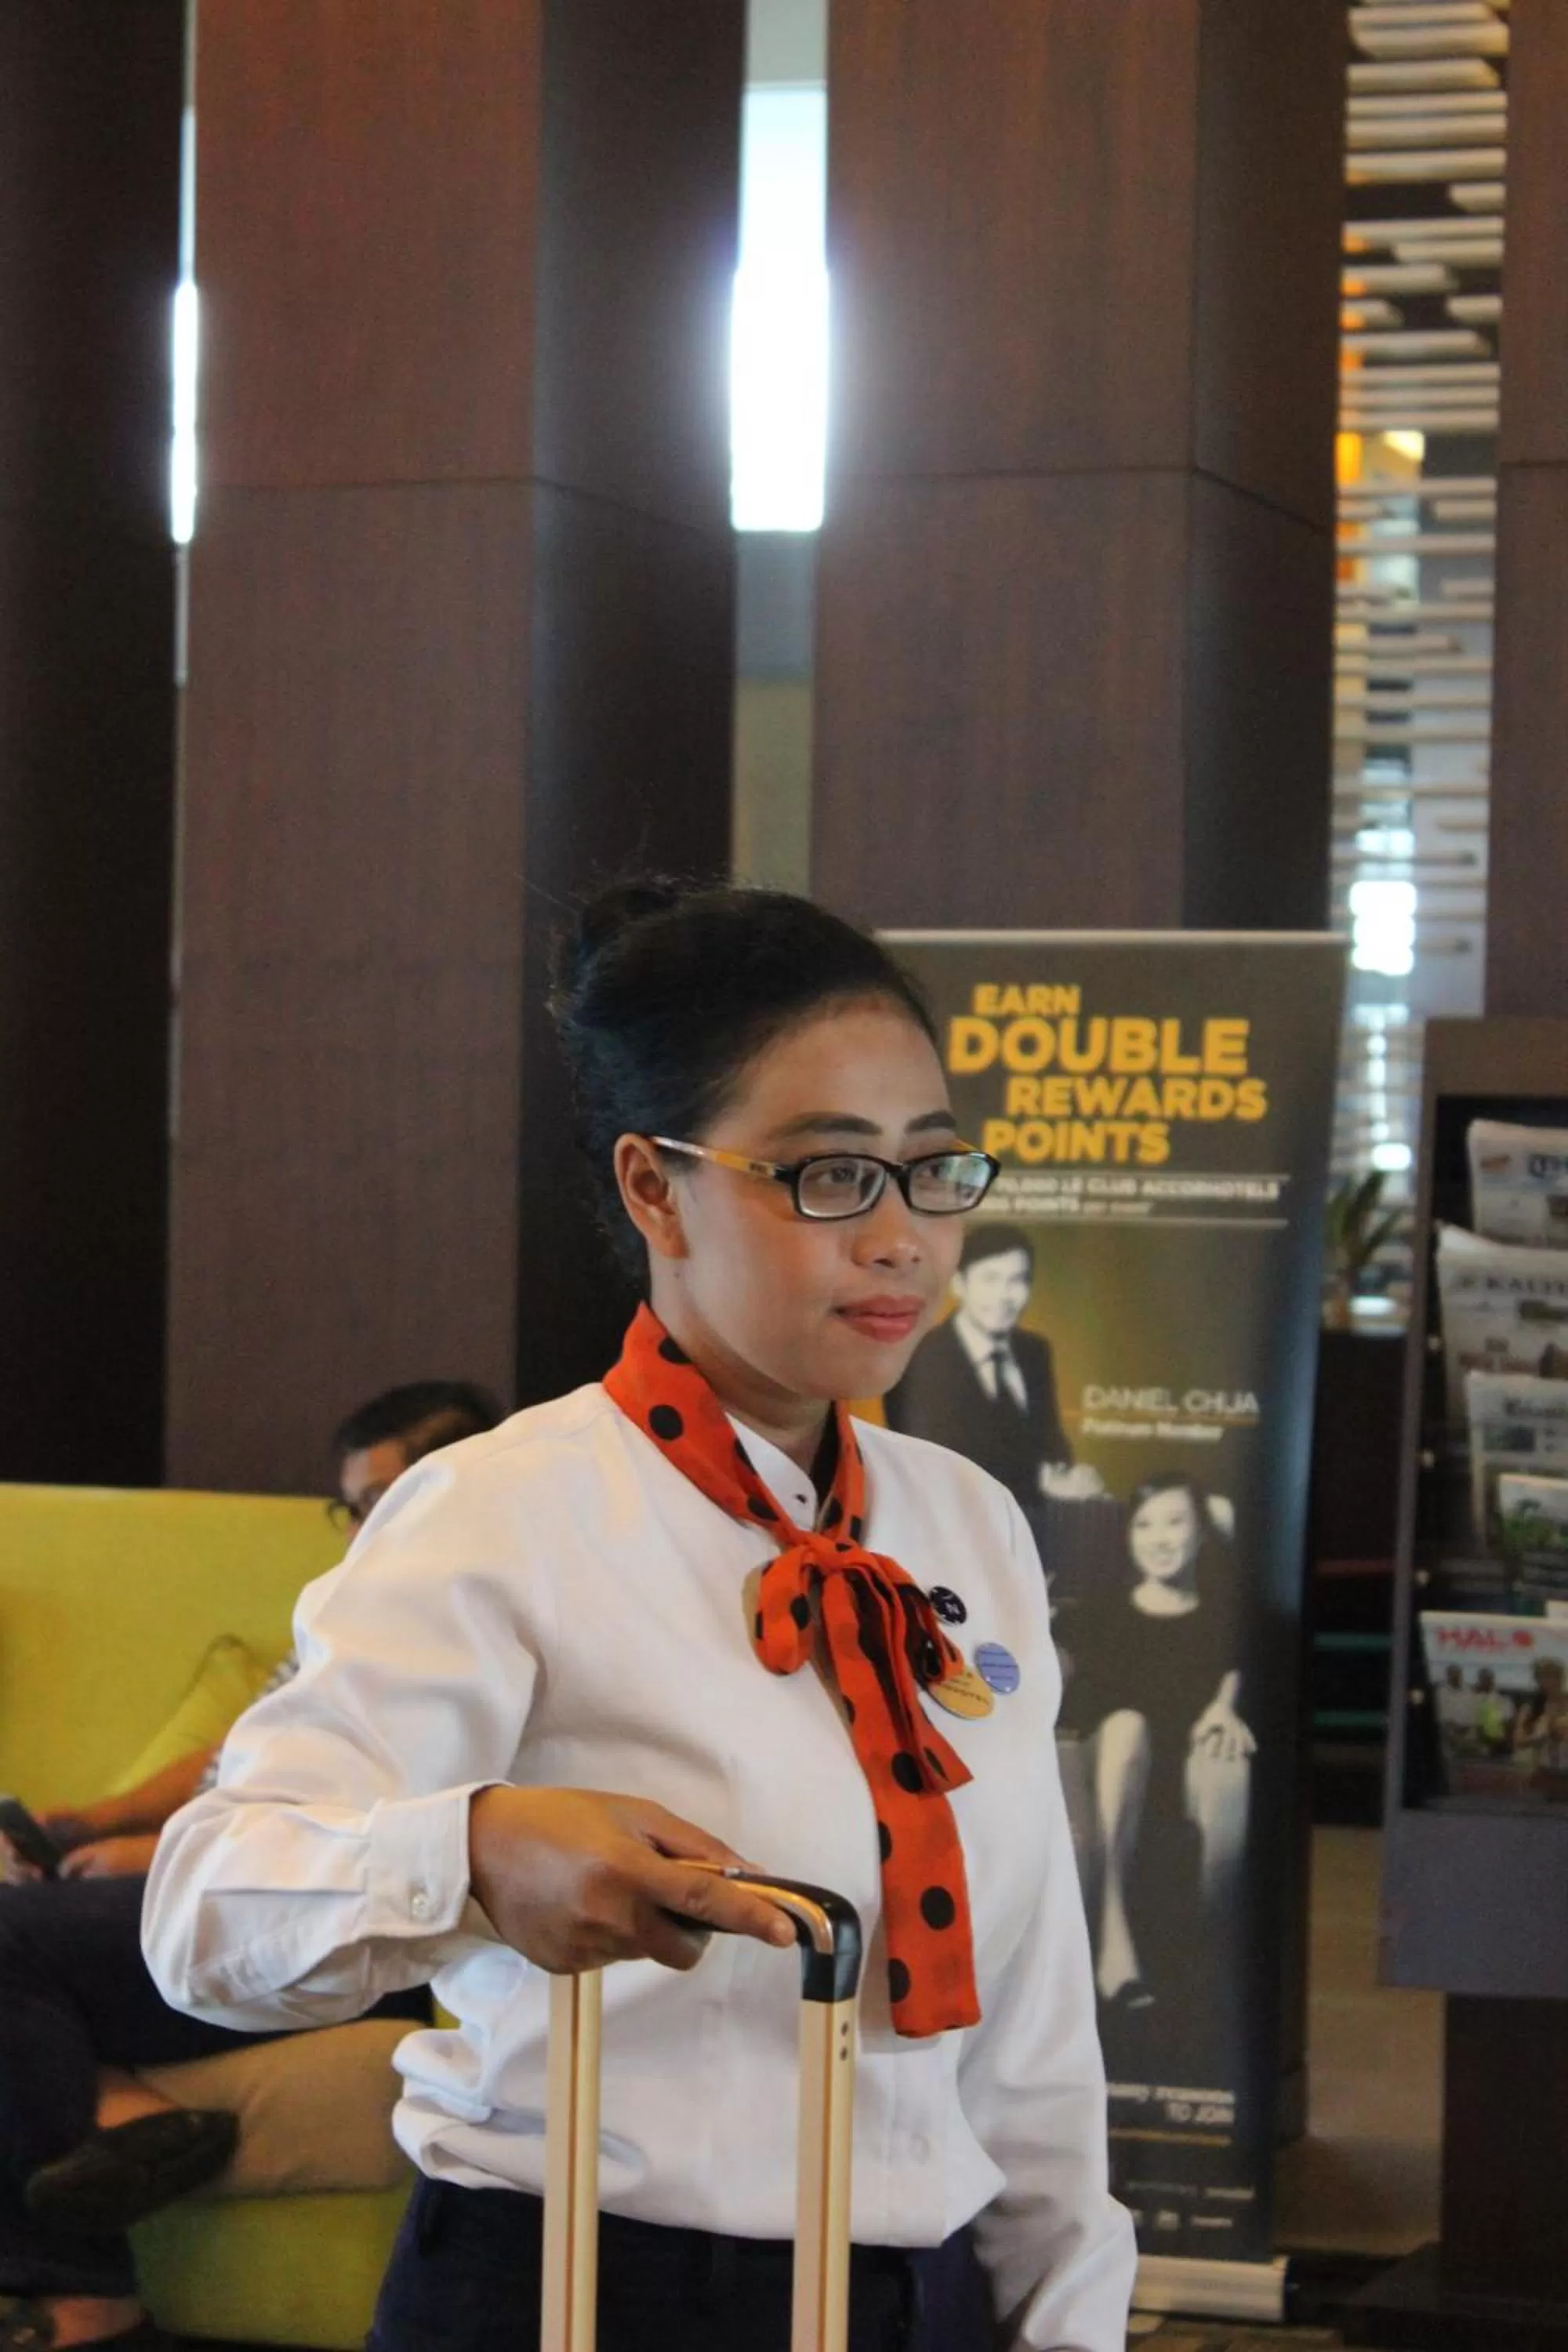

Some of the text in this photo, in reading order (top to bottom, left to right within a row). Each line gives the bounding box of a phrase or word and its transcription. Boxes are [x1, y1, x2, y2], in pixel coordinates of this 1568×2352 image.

[973, 984, 1081, 1017] EARN
[947, 1016, 1250, 1076] DOUBLE
[1006, 1077, 1268, 1120] REWARDS
[982, 1120, 1171, 1164] POINTS
[1087, 1178, 1137, 1196] CLUB
